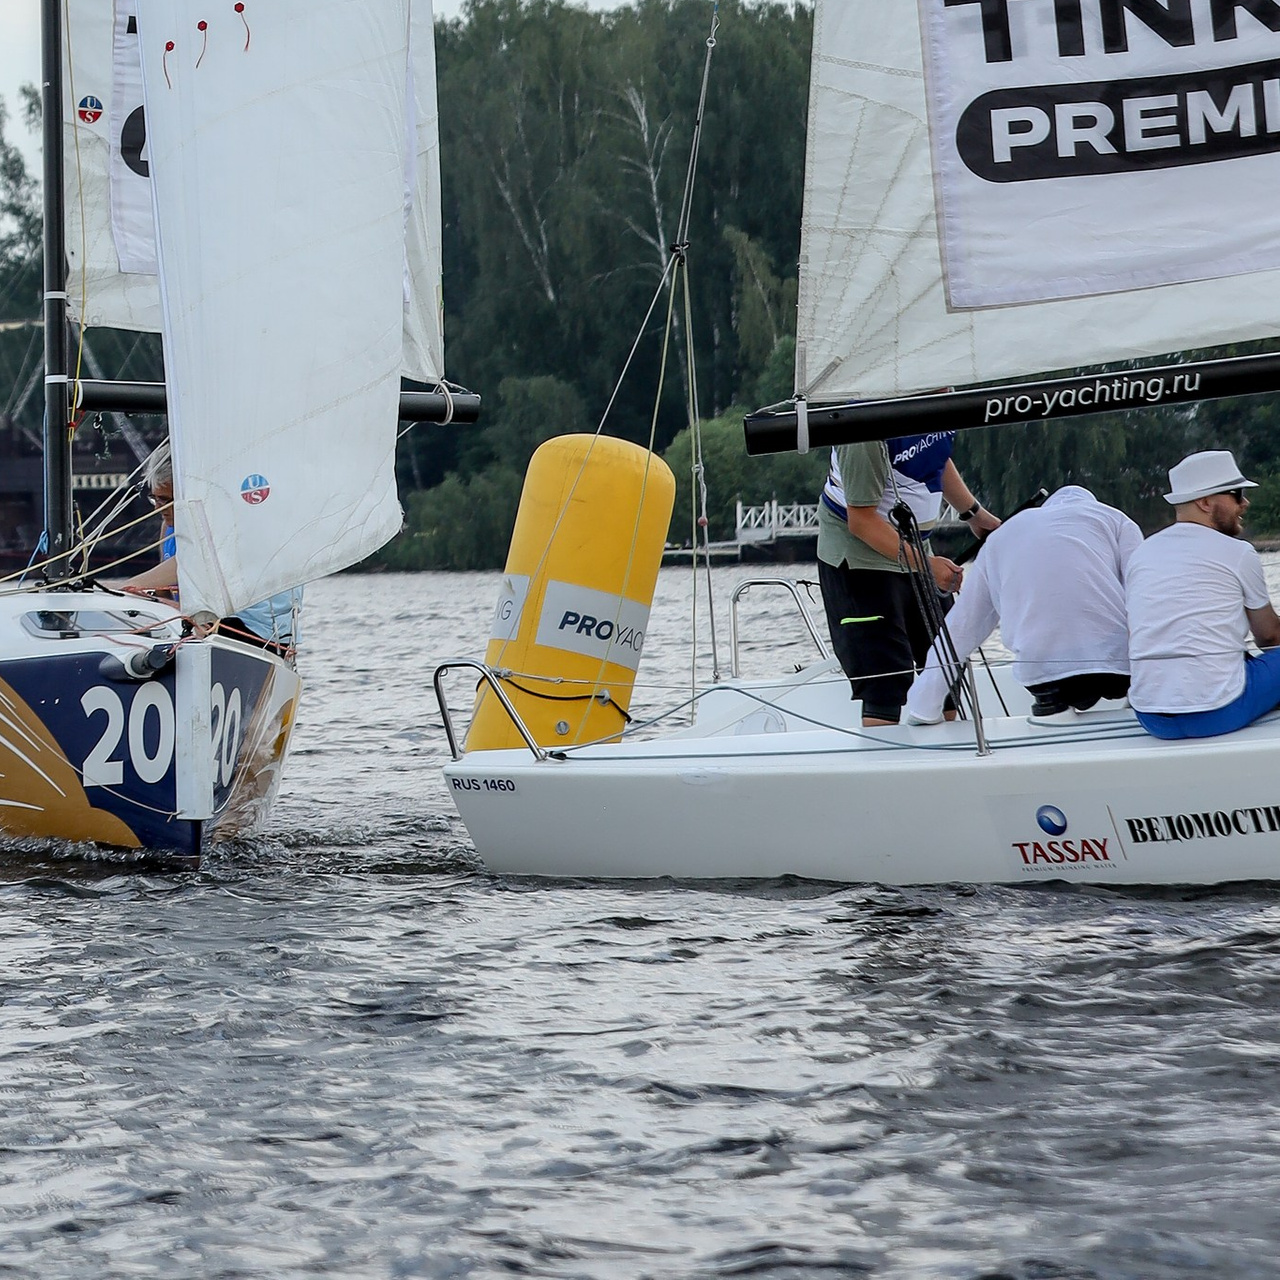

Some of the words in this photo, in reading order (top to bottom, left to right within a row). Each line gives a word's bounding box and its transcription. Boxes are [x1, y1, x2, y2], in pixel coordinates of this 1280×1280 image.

[984, 372, 1201, 423] pro-yachting.ru
[80, 680, 175, 787] 20
[451, 778, 481, 791] RUS
[483, 779, 516, 792] 1460
[1011, 838, 1110, 865] TASSAY
